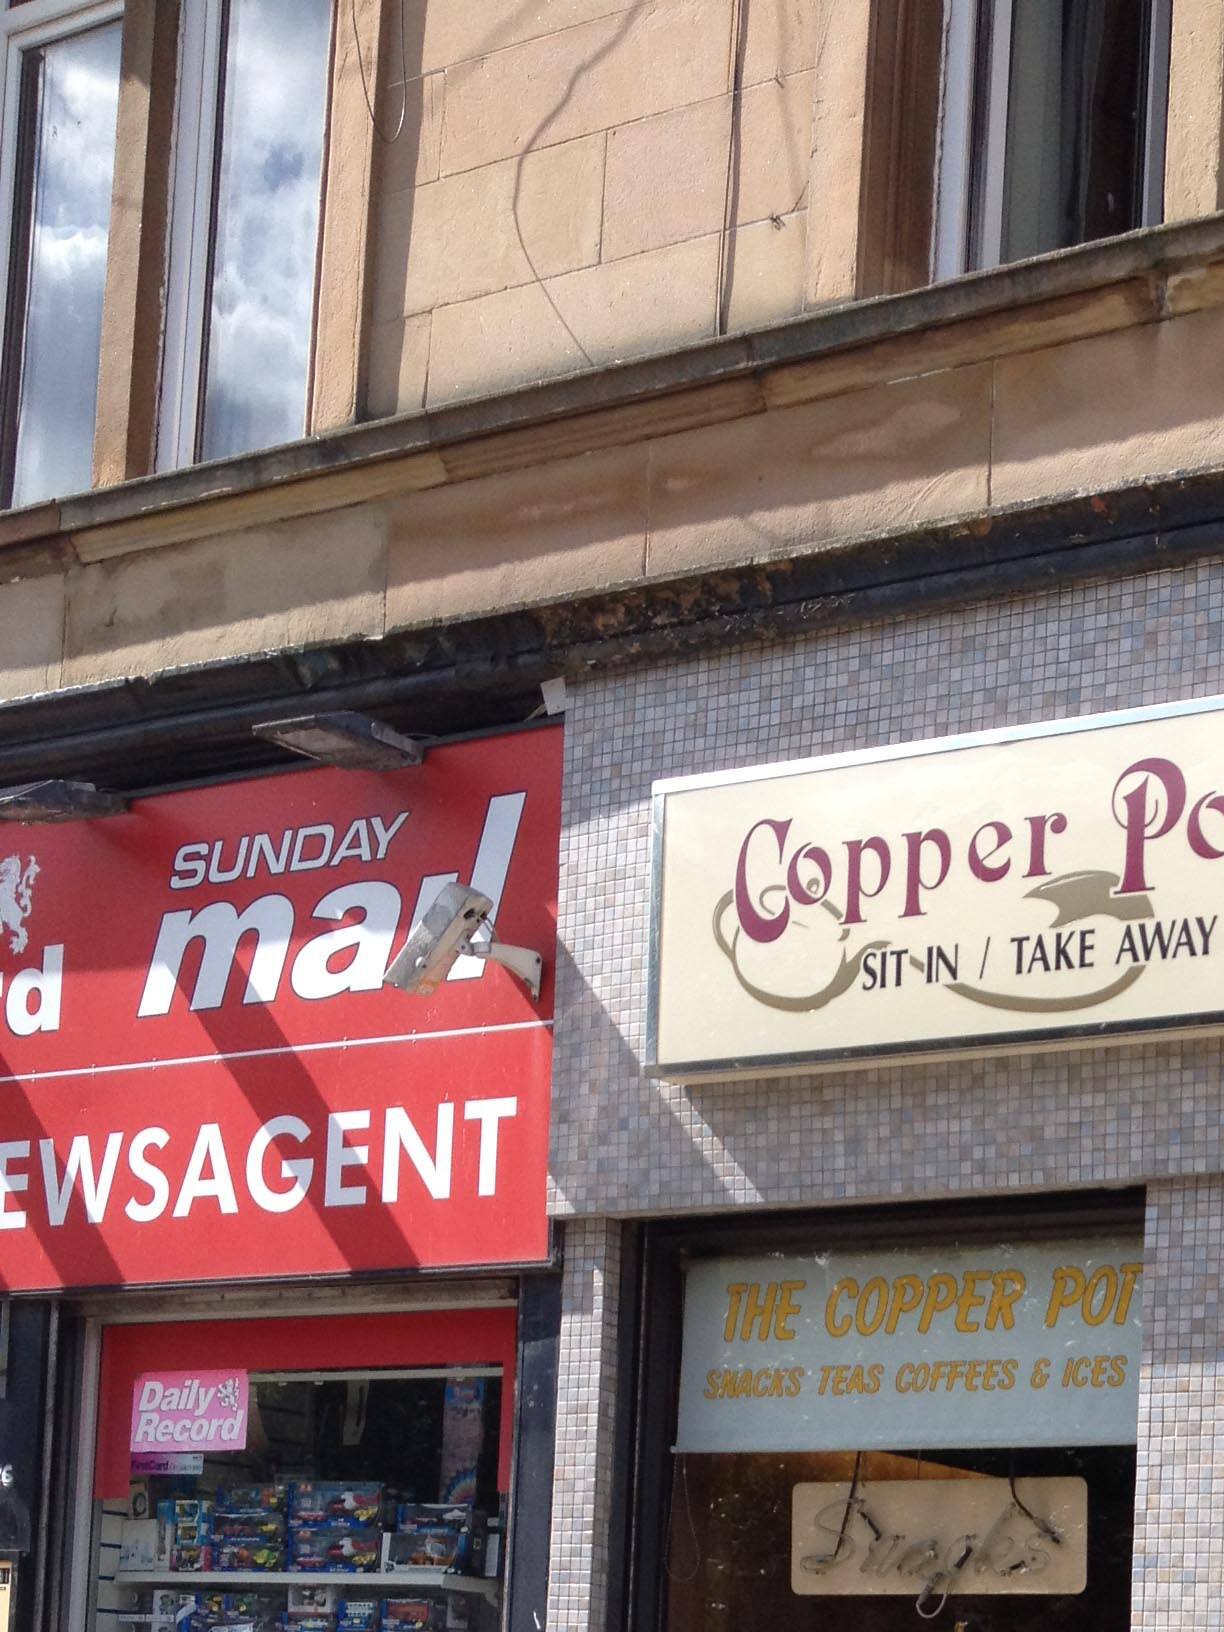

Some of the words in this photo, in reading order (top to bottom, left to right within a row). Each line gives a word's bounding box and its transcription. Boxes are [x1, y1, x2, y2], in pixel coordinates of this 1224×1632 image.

[169, 811, 410, 890] SUNDAY
[735, 812, 1068, 943] Copper
[1010, 928, 1096, 976] TAKE
[1115, 915, 1218, 965] AWAY
[723, 1279, 808, 1343] THE
[824, 1268, 1027, 1338] COPPER
[1044, 1263, 1145, 1329] POT
[138, 1379, 217, 1416] Daily
[702, 1367, 805, 1400] SNACKS
[817, 1363, 885, 1396] TEAS
[895, 1359, 1020, 1394] COFFEES
[1030, 1357, 1051, 1390] &
[1061, 1355, 1130, 1388] ICES
[133, 1409, 244, 1443] Record
